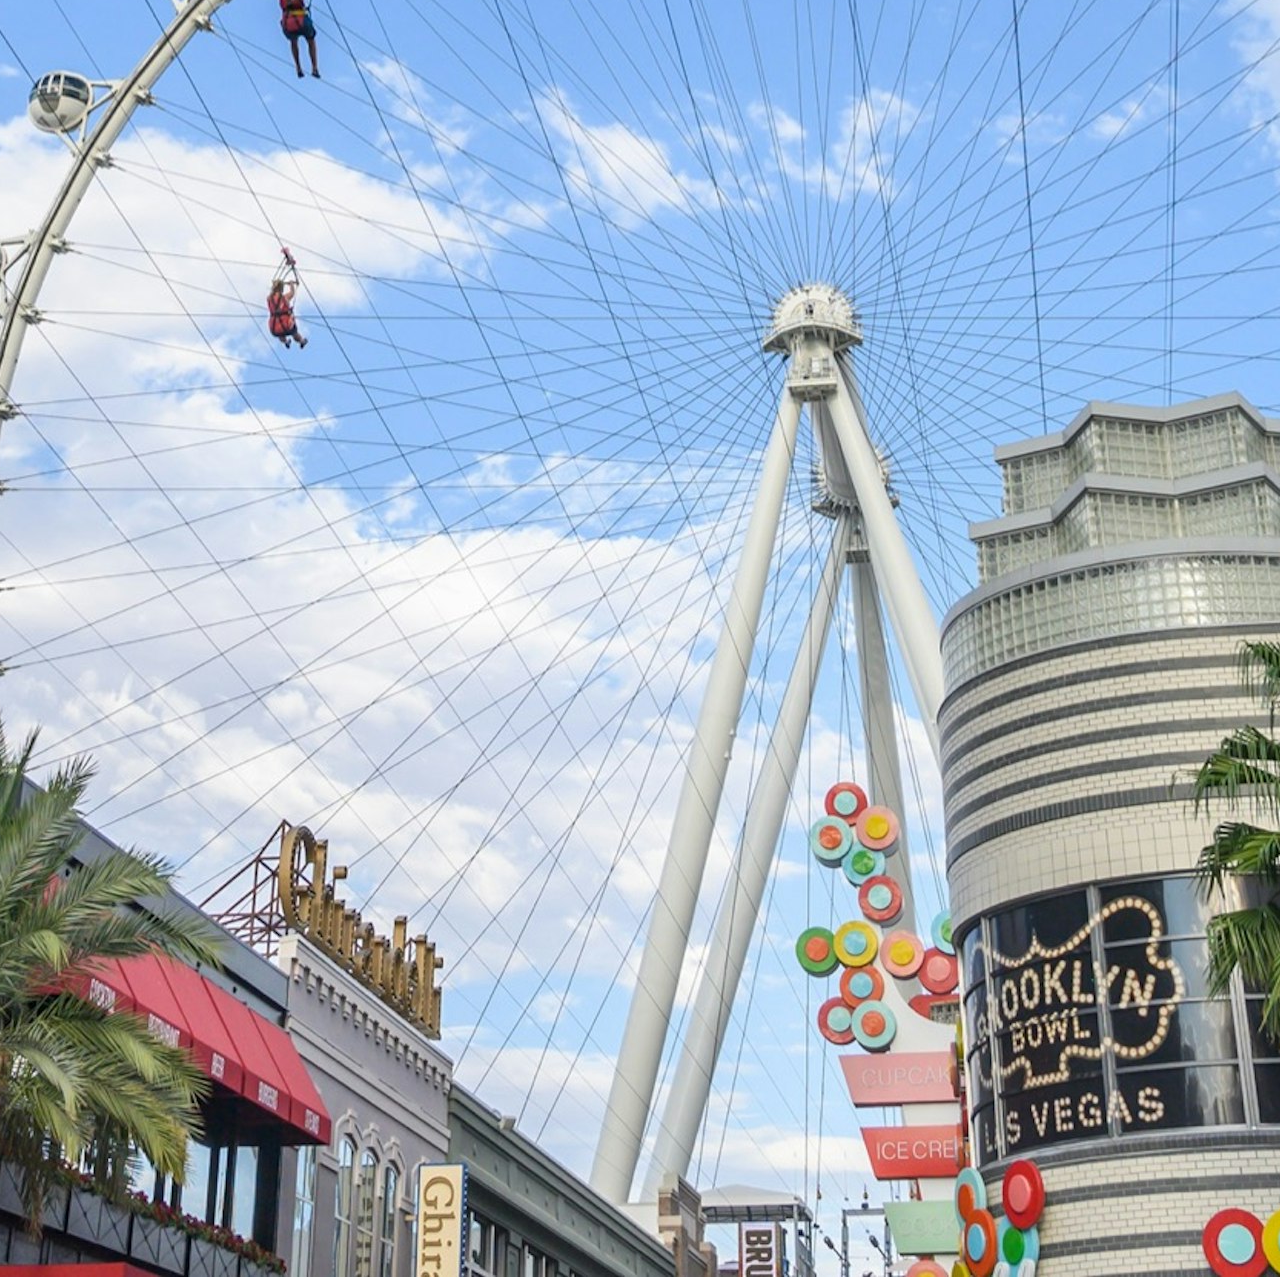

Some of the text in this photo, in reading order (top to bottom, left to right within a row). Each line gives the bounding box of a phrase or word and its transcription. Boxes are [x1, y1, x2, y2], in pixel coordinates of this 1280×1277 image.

[1010, 1007, 1092, 1053] BOWL
[1031, 1086, 1164, 1137] VEGAS
[876, 1141, 908, 1160] ICE
